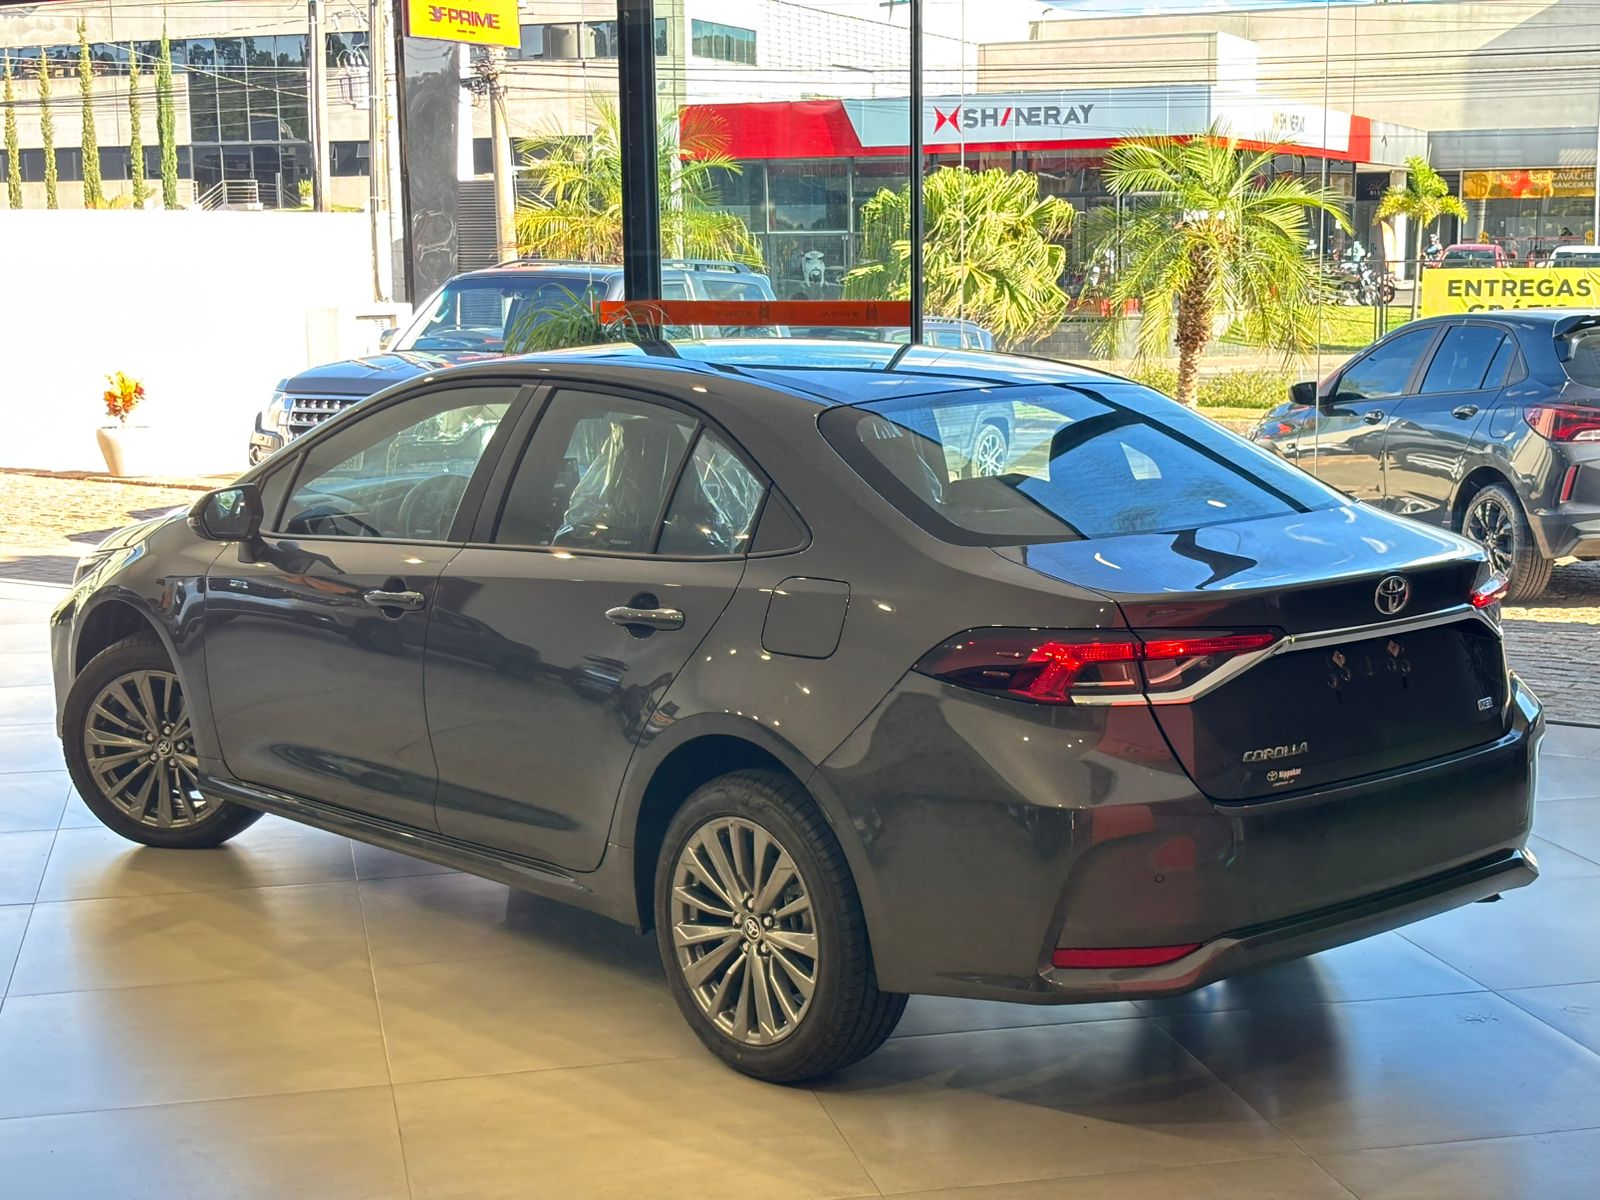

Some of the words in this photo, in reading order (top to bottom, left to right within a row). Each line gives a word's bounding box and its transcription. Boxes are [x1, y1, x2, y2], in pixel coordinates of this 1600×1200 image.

[448, 8, 500, 29] PRIME
[963, 103, 1094, 128] SHINERAY
[1447, 279, 1592, 297] ENTREGAS
[1242, 741, 1309, 763] COROLLA
